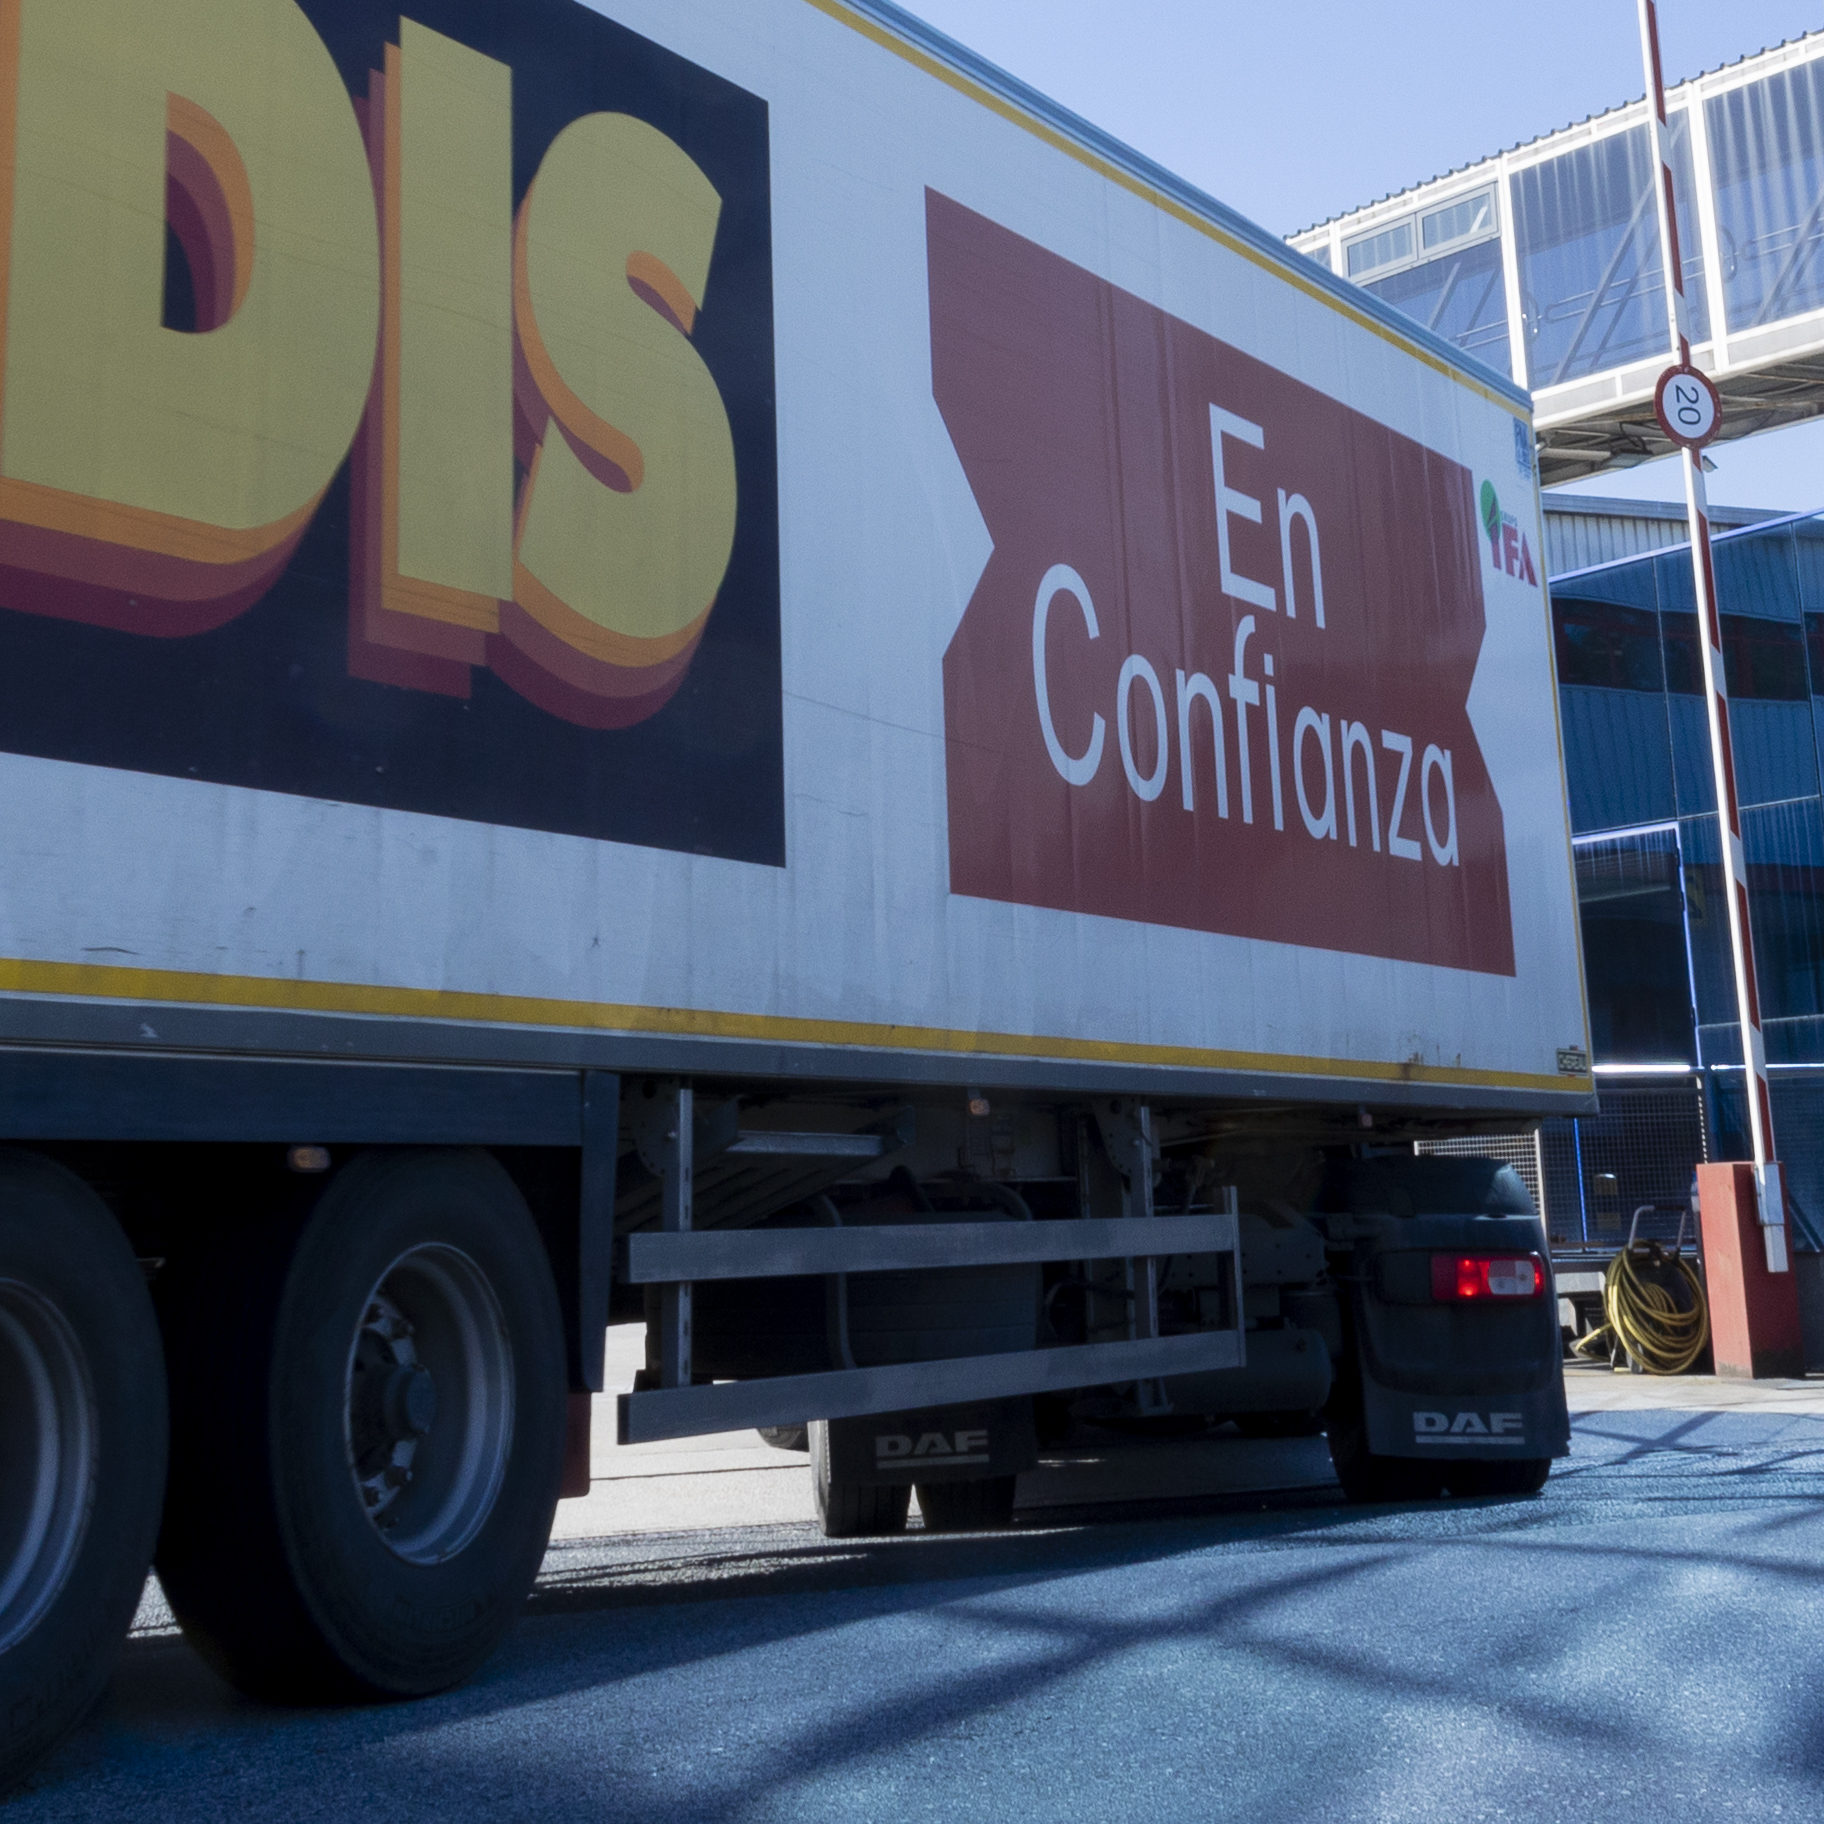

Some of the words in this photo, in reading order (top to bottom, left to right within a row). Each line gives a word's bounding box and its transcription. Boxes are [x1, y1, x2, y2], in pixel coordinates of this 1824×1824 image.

[1675, 384, 1701, 425] 20
[1209, 402, 1326, 630] En
[1031, 563, 1460, 867] Confianza
[1413, 1412, 1524, 1435] DAF
[876, 1429, 989, 1460] DAF
